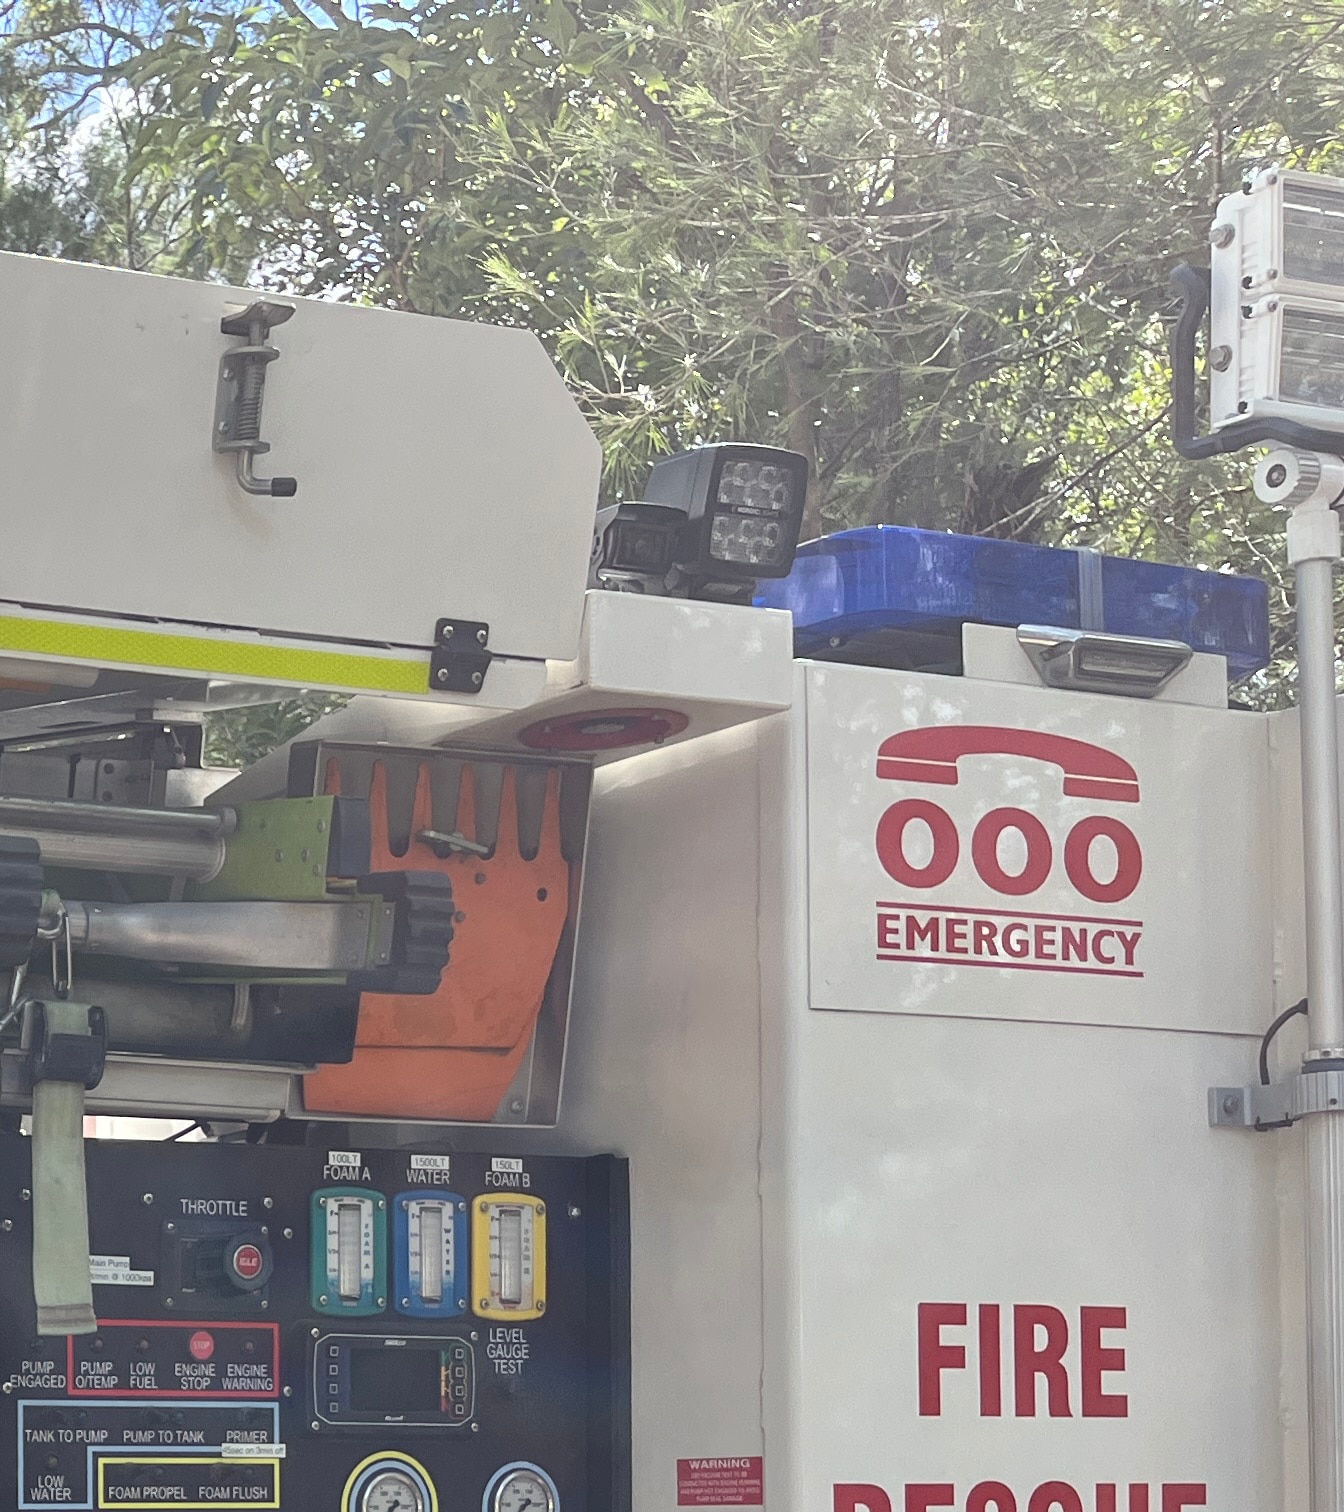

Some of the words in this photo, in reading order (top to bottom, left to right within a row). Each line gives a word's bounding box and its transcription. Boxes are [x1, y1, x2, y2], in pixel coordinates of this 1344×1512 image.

[877, 913, 1142, 966] EMERGENCY
[331, 1154, 358, 1164] 100LT
[415, 1157, 446, 1168] 1500LT
[323, 1165, 360, 1180] FOAM
[362, 1167, 371, 1182] A
[406, 1169, 450, 1184] WATER
[485, 1172, 520, 1187] FOAM
[523, 1173, 531, 1188] B
[180, 1199, 248, 1217] THROTTLE
[444, 1227, 452, 1276] WATER
[108, 1260, 128, 1269] Pump
[489, 1328, 527, 1343] LEVEL
[487, 1344, 529, 1359] GAUGE
[493, 1359, 524, 1375] TEST
[917, 1303, 1128, 1418] FIRE
[21, 1361, 54, 1375] PUMP
[80, 1362, 112, 1375] PUMP
[130, 1362, 155, 1375] LOW
[175, 1363, 216, 1377] ENGINE
[227, 1364, 268, 1378] ENGINE
[10, 1375, 66, 1388] ENGAGED
[75, 1375, 118, 1389] O/TEMP
[130, 1375, 158, 1389] FUEL
[180, 1377, 211, 1390] STOP
[221, 1378, 273, 1391] WARNING
[25, 1430, 54, 1443] TANK
[58, 1430, 73, 1443] TO
[76, 1430, 108, 1443] PUMP
[123, 1430, 155, 1443] PUMP
[158, 1430, 173, 1443] TO
[176, 1430, 204, 1443] TANK
[226, 1430, 268, 1443] PRIMER
[688, 1459, 750, 1470] WARNING
[37, 1475, 64, 1488] LOW
[30, 1488, 72, 1501] WATER
[108, 1487, 141, 1500] FOAM
[143, 1487, 187, 1500] PROPEL
[199, 1486, 230, 1499] FOAM
[232, 1486, 268, 1499] FLUSH
